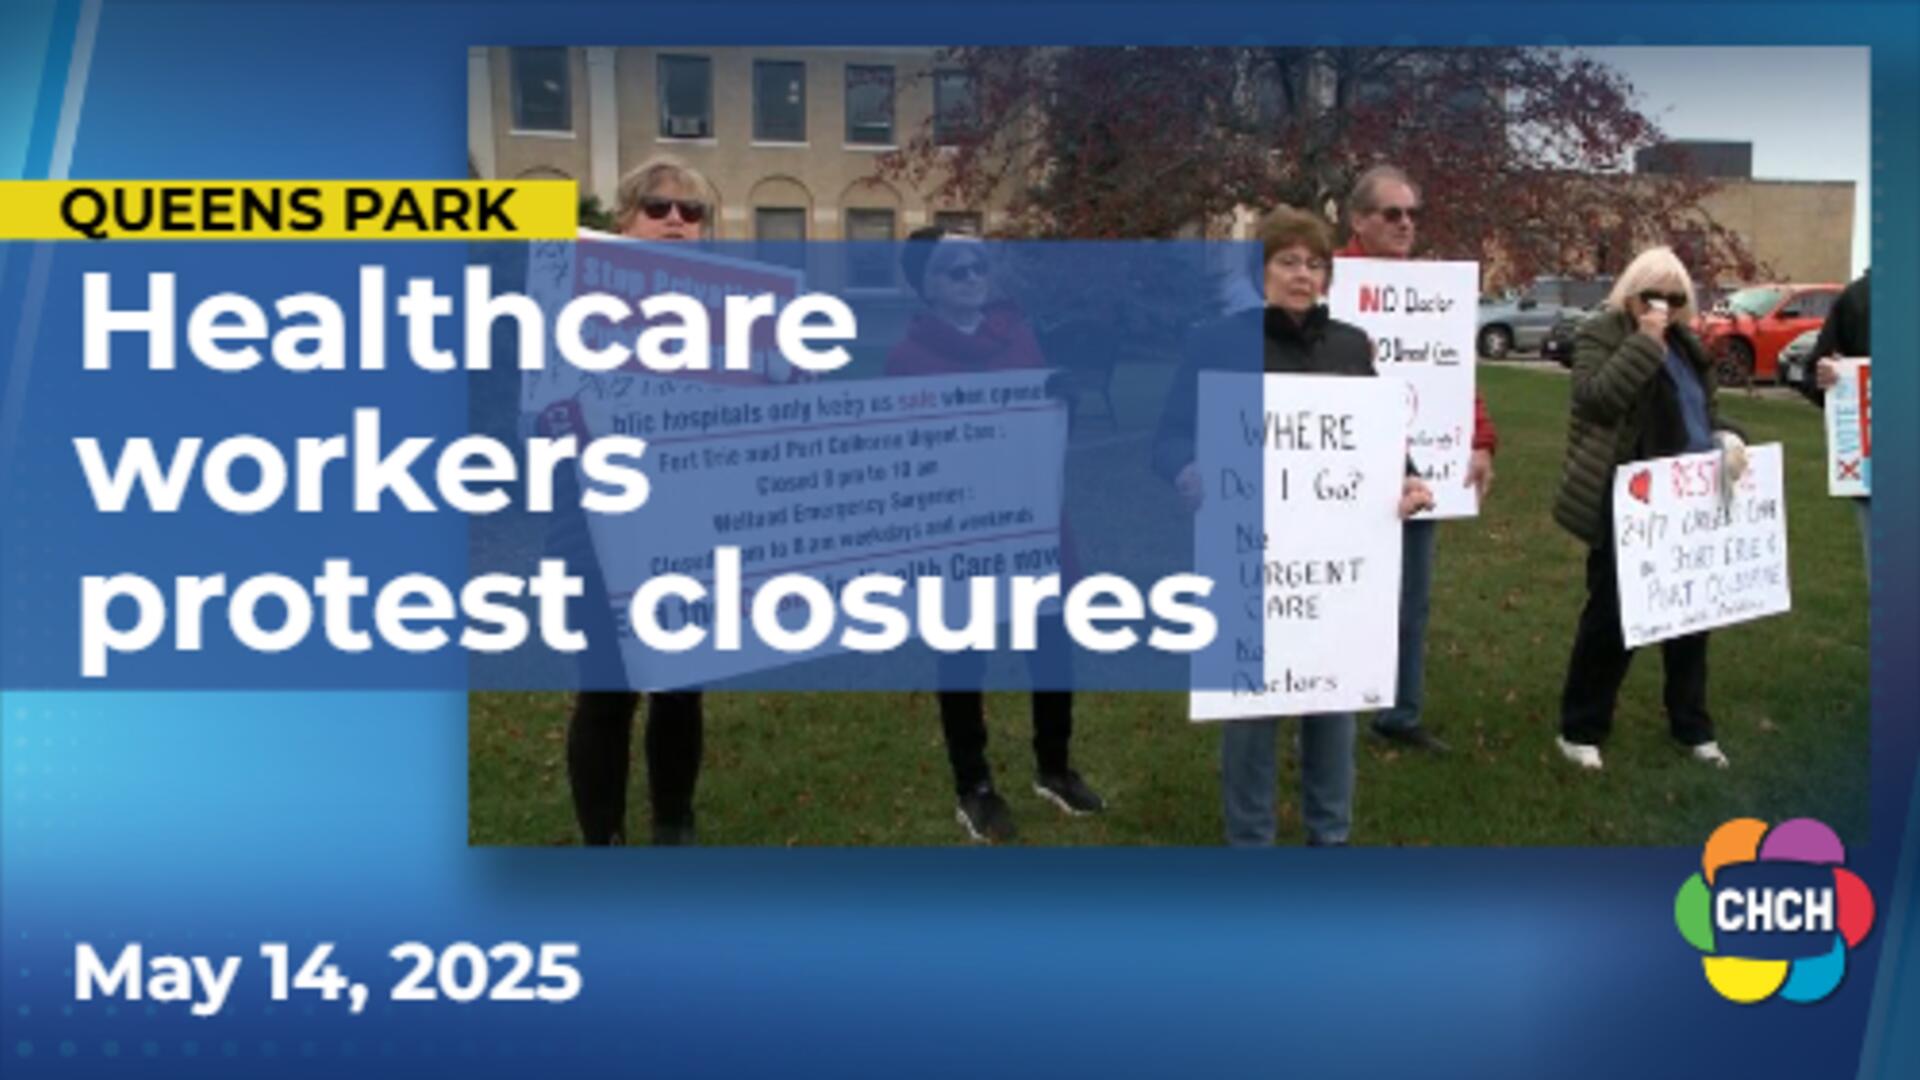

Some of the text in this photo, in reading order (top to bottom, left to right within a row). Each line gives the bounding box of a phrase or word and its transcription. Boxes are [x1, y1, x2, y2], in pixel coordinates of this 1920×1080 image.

[1359, 285, 1398, 313] NO
[663, 403, 762, 432] hospitals
[768, 398, 812, 422] only
[818, 391, 865, 418] keep
[870, 394, 894, 412] us
[1239, 408, 1358, 451] WHERE
[658, 449, 698, 473] Fort
[756, 470, 819, 496] Closed
[1281, 467, 1288, 501] I
[951, 552, 1006, 583] Care
[1239, 557, 1366, 589] URGENT
[1244, 593, 1321, 620] CARE
